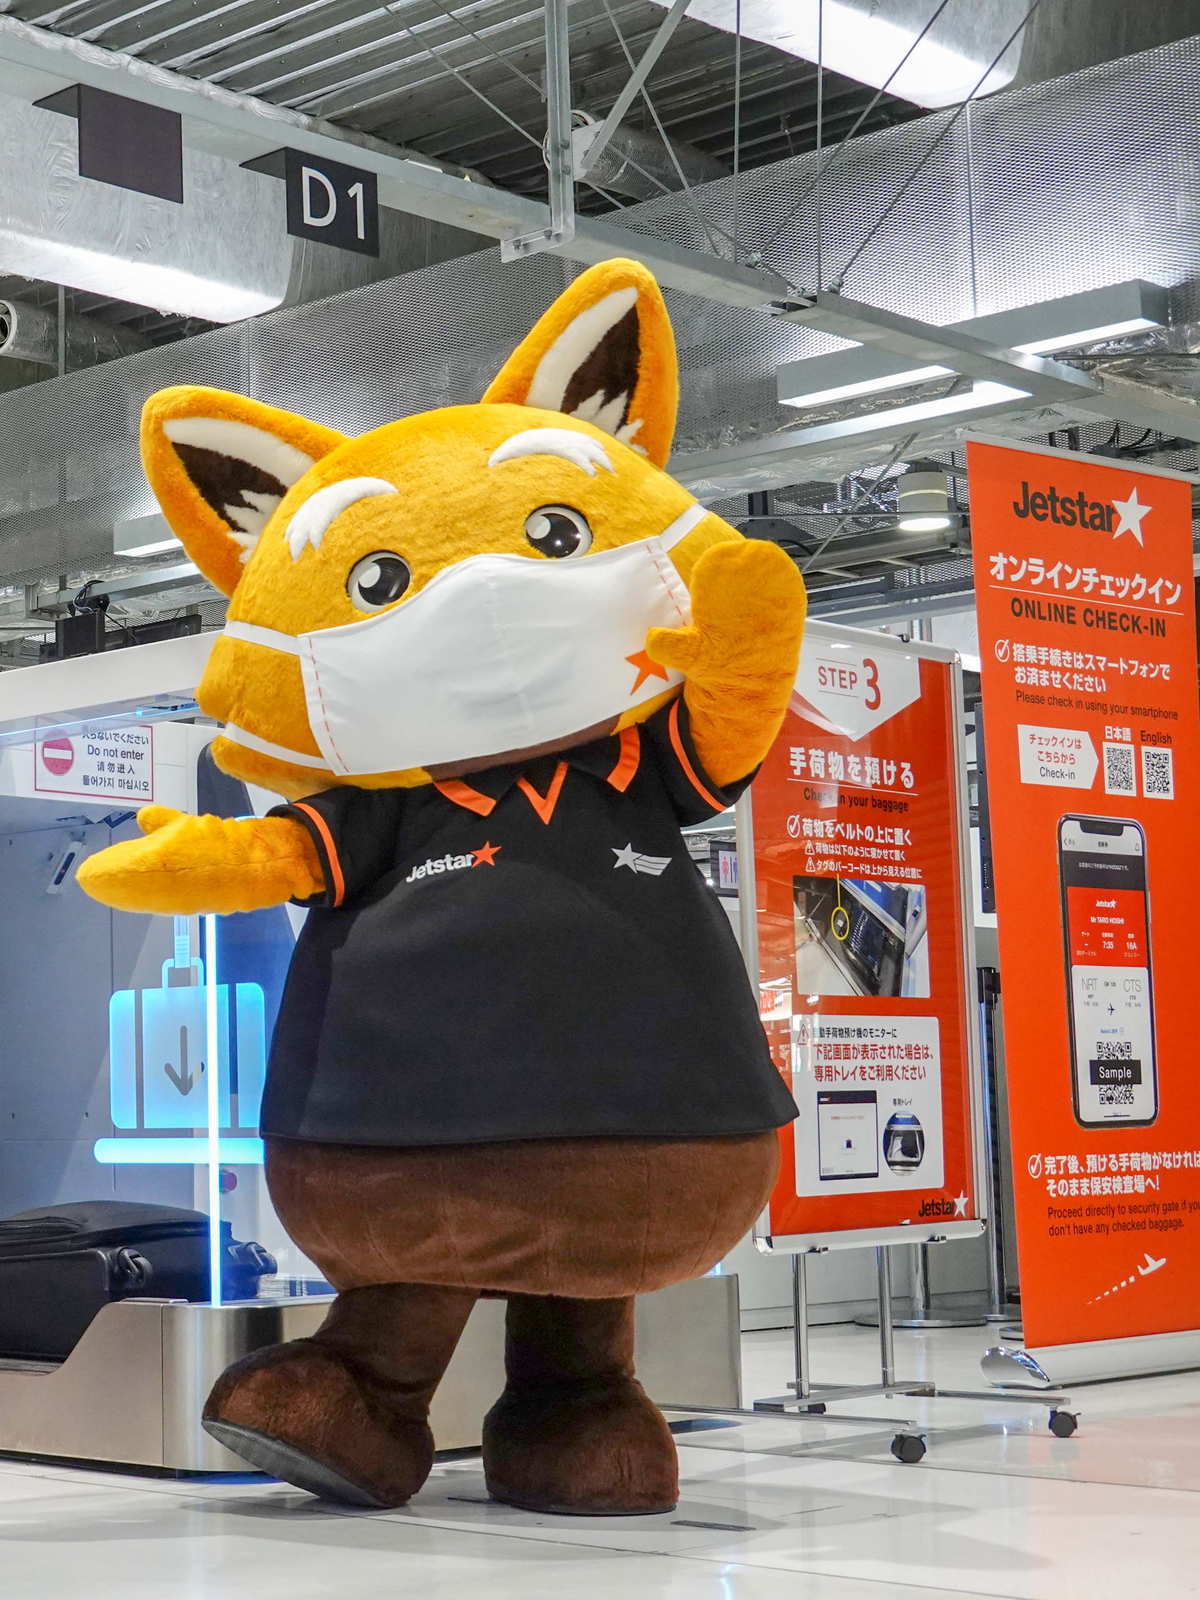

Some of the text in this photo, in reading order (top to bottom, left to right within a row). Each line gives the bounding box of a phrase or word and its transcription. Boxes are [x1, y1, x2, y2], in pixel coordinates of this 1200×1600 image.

[301, 167, 365, 240] D1
[1013, 481, 1117, 533] Jetstar
[989, 552, 1182, 605] オンラインチェックイン
[1011, 598, 1166, 637] ONLINE CHECK-IN
[1012, 643, 1170, 680] 搭乗手続きはスマートフォンで
[818, 658, 881, 710] STEP 3
[1014, 666, 1106, 693] お済ませください
[1015, 690, 1178, 720] Please check in using your smartphone
[1029, 733, 1082, 749] チェックインは
[1104, 726, 1131, 741] 日本語
[1140, 730, 1172, 746] English
[87, 744, 144, 760] Do not enter
[1037, 751, 1076, 765] こちらから
[790, 746, 914, 789] 手荷物を預ける
[1039, 766, 1076, 780] Check-in
[118, 778, 149, 791] 마십시오
[803, 787, 834, 802] Che
[848, 796, 869, 807] your
[871, 796, 909, 813] baggage
[802, 818, 912, 846] 荷物をベルトの上に置く
[406, 854, 475, 883] Jetstar
[1123, 979, 1142, 992] CTS
[813, 1027, 897, 1039] 動手荷物預け機のモニターに
[814, 1043, 934, 1060] 下記画面が表示された場合は、
[814, 1064, 926, 1082] 専用トレイをご利用ください
[1099, 1066, 1132, 1084] Sample
[1047, 1207, 1083, 1219] Proceed
[1086, 1203, 1115, 1218] directly
[1117, 1204, 1126, 1215] to
[1128, 1201, 1160, 1216] security
[1162, 1201, 1179, 1215] gate
[1048, 1224, 1071, 1237] don't
[1073, 1223, 1093, 1235] have
[1096, 1223, 1109, 1237] any
[1112, 1220, 1146, 1233] checked
